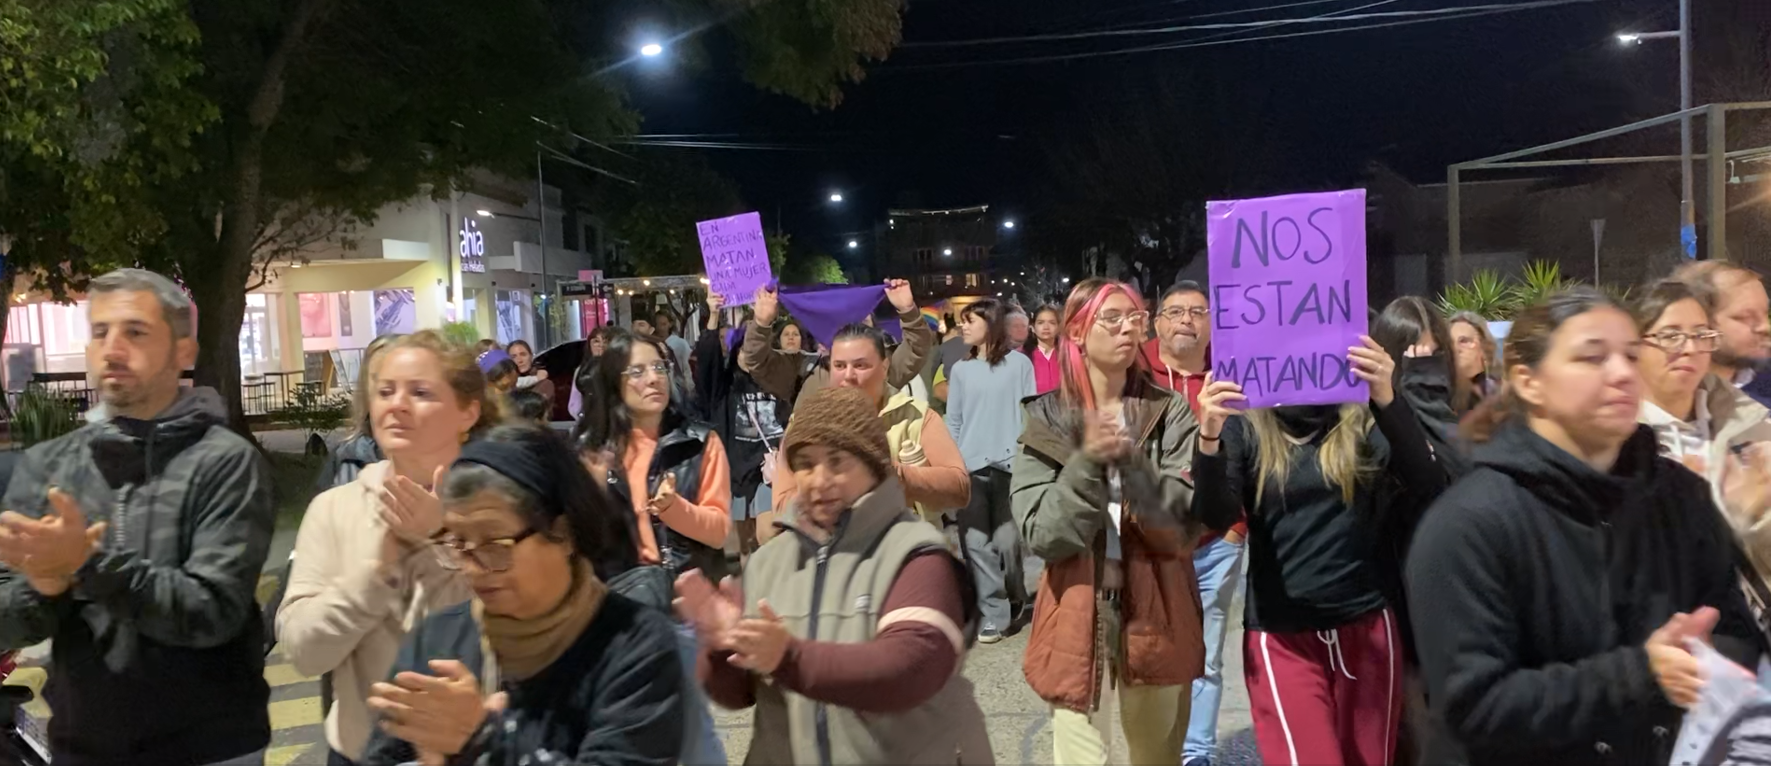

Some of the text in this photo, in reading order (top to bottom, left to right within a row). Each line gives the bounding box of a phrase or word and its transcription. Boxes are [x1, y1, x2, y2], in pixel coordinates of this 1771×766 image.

[700, 221, 719, 235] EN
[1231, 207, 1333, 268] NOS
[702, 229, 763, 251] ARGENTINA
[706, 248, 755, 268] MATAN
[711, 262, 769, 282] UNA MUJER
[1214, 280, 1351, 330] ESTAN
[1215, 351, 1360, 397] MATANDO
